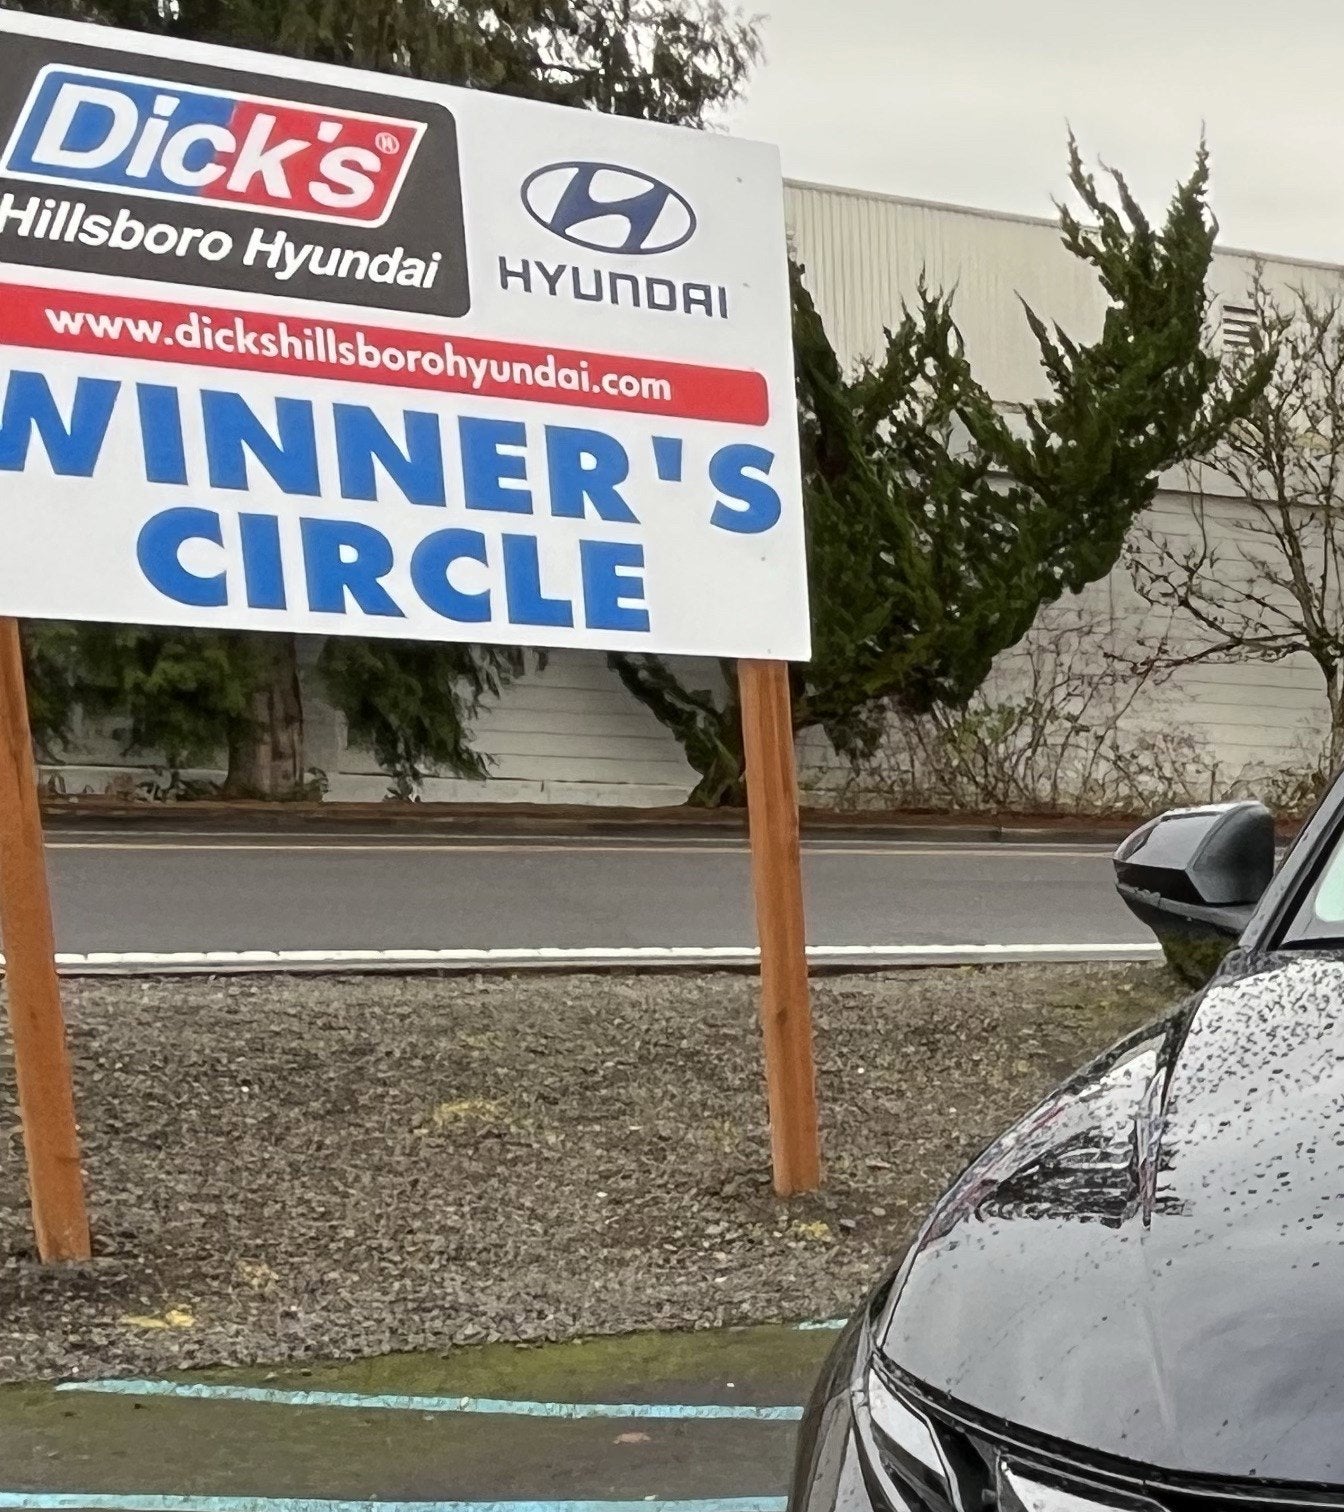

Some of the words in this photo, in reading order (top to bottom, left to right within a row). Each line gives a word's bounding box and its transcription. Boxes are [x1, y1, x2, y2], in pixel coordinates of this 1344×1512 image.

[30, 82, 382, 209] Dick's
[0, 193, 233, 261] Hillsboro
[243, 228, 442, 290] Hyundai
[498, 256, 729, 320] HYUNDAI
[45, 307, 673, 401] www.dickshillsborohyundai.com
[136, 506, 651, 632] CIRCLE
